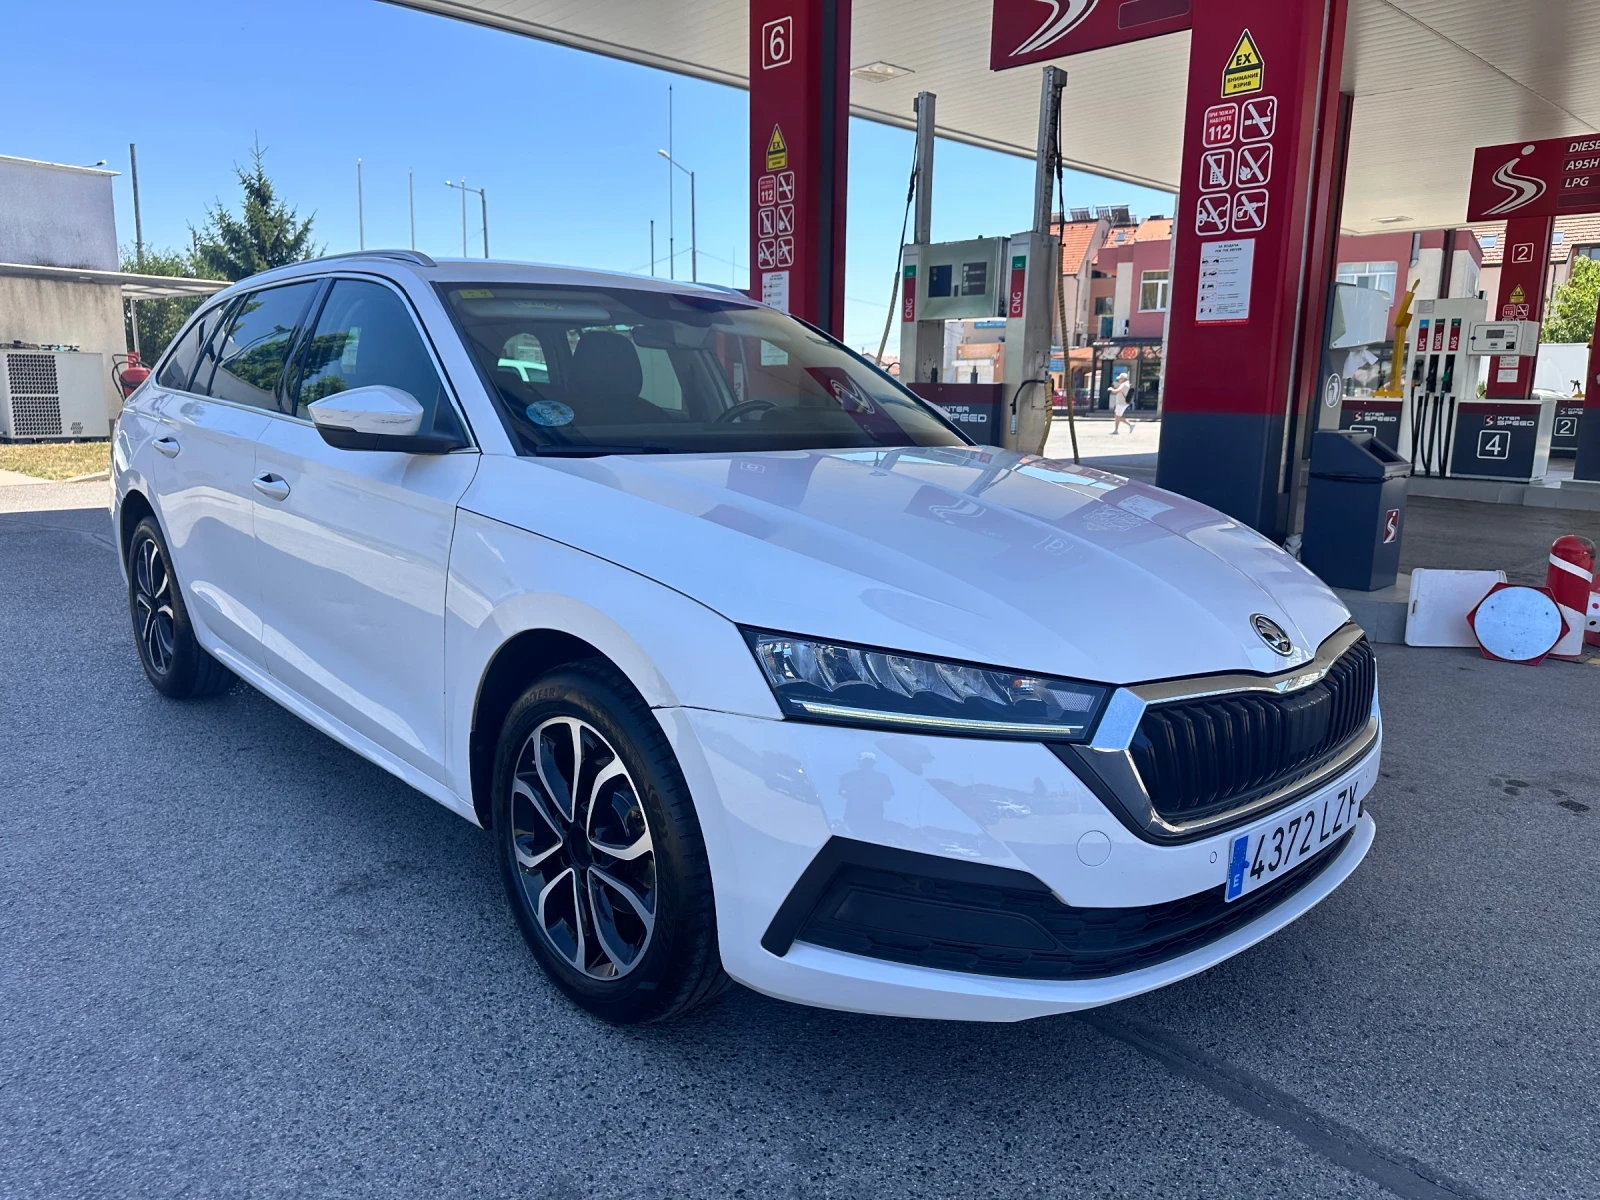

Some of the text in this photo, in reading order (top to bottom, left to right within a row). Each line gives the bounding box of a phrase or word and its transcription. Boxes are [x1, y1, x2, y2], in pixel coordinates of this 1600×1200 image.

[770, 25, 785, 61] 6
[1236, 52, 1252, 66] EX
[1227, 72, 1259, 84] ВНИМАНИЕ
[1233, 80, 1252, 89] ВЗРИВ
[1208, 124, 1232, 141] 112
[773, 141, 781, 149] EX
[1565, 176, 1590, 188] LPG
[761, 190, 774, 202] 112
[1517, 247, 1528, 260] 2
[905, 298, 914, 319] CNG
[1012, 291, 1022, 314] CNG
[1418, 337, 1426, 351] LPG
[1434, 332, 1443, 350] DIESEL
[1449, 336, 1458, 349] A95
[950, 413, 987, 423] PEED
[1559, 420, 1571, 434] 2
[1485, 434, 1501, 455] 4
[1250, 781, 1359, 880] 4372 LZY
[1233, 873, 1240, 888] E
